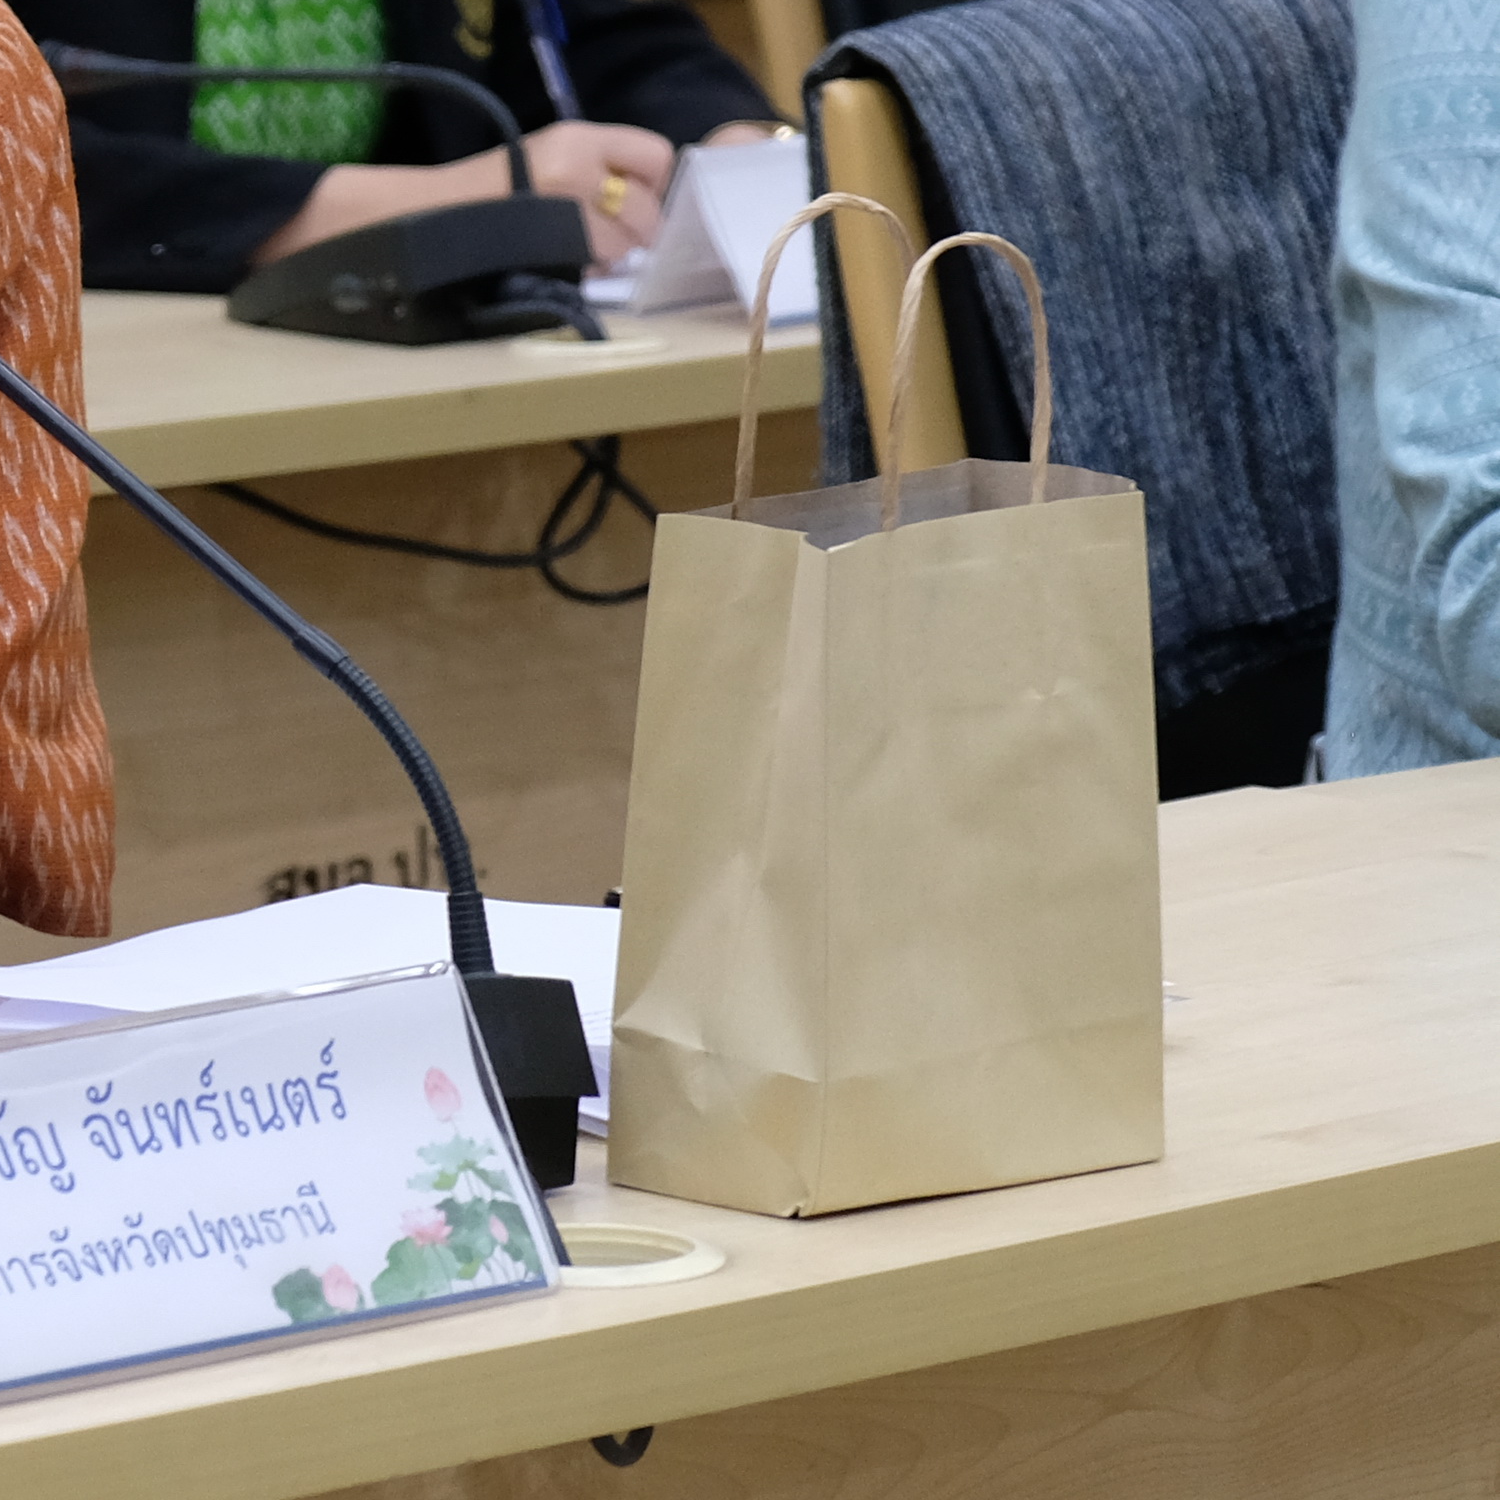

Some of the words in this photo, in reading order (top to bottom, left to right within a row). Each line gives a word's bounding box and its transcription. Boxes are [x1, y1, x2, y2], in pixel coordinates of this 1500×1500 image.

[81, 1038, 347, 1161] จันทร์เนตร์
